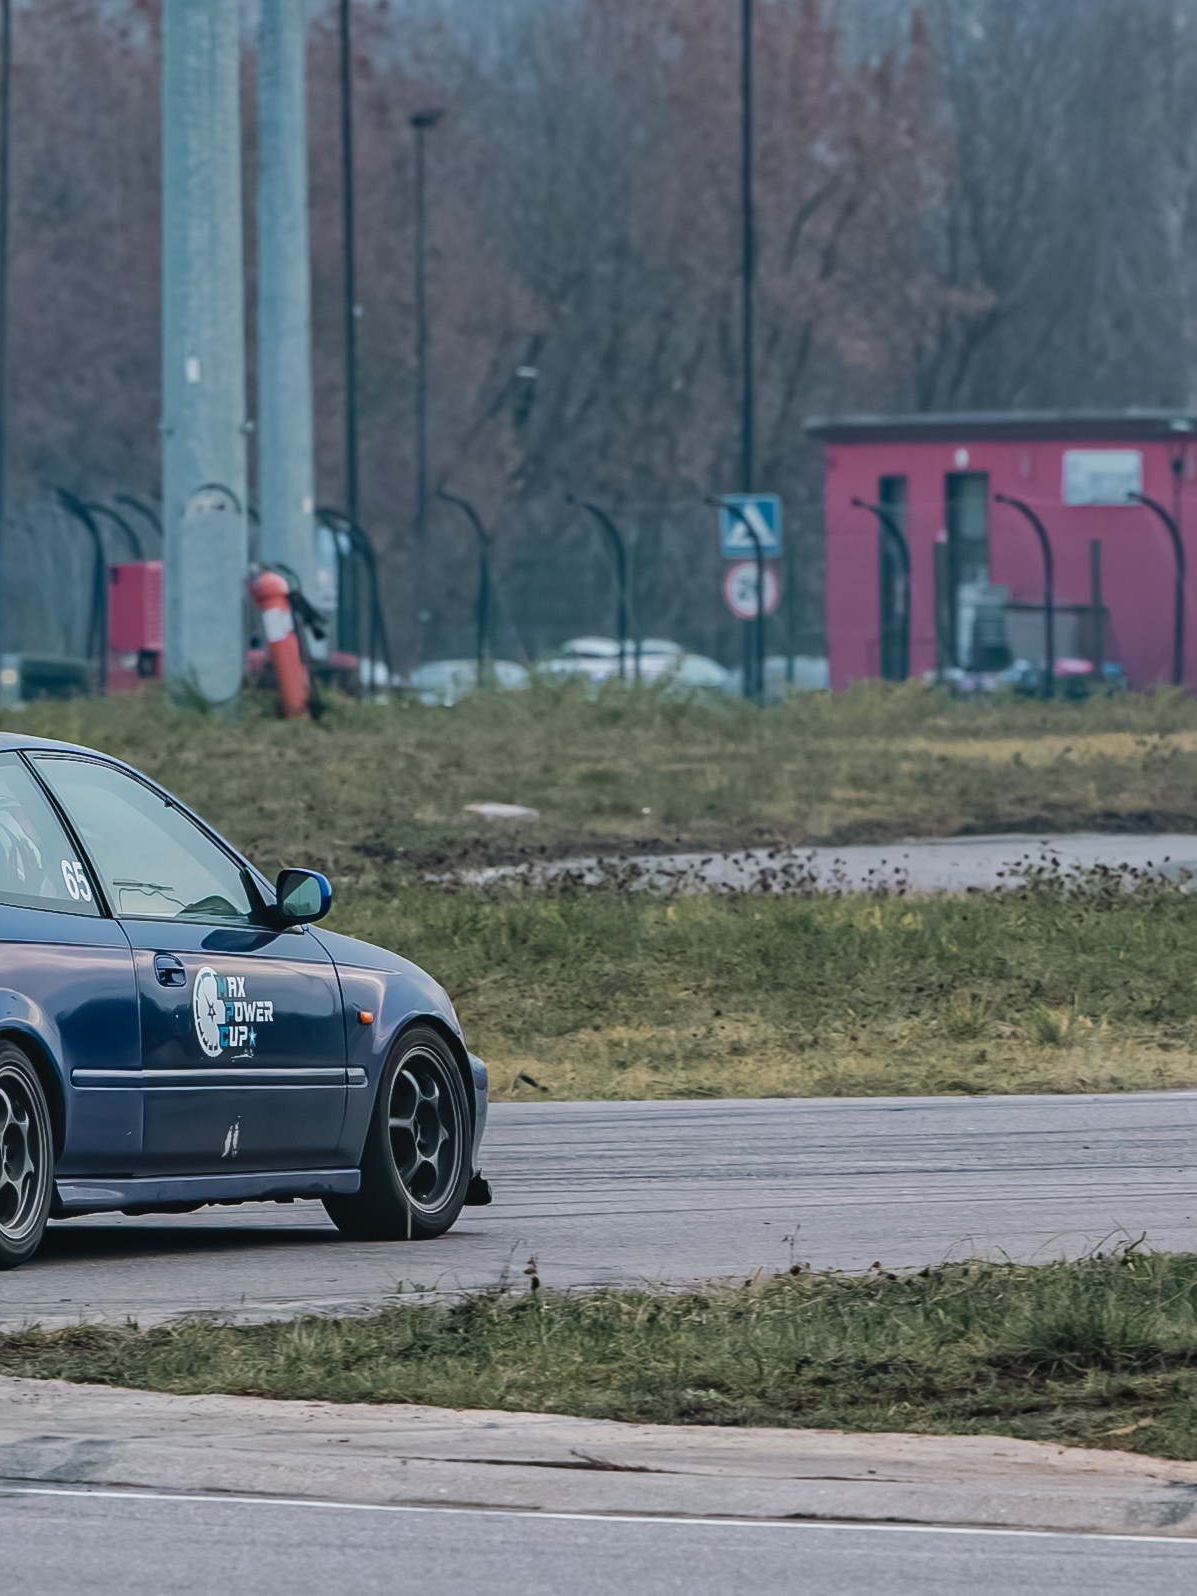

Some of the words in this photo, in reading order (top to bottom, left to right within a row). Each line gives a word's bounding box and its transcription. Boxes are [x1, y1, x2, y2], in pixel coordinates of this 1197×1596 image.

[61, 859, 92, 902] 65
[215, 976, 247, 998] MAX
[224, 1001, 274, 1022] POWER
[219, 1026, 249, 1047] CUP
